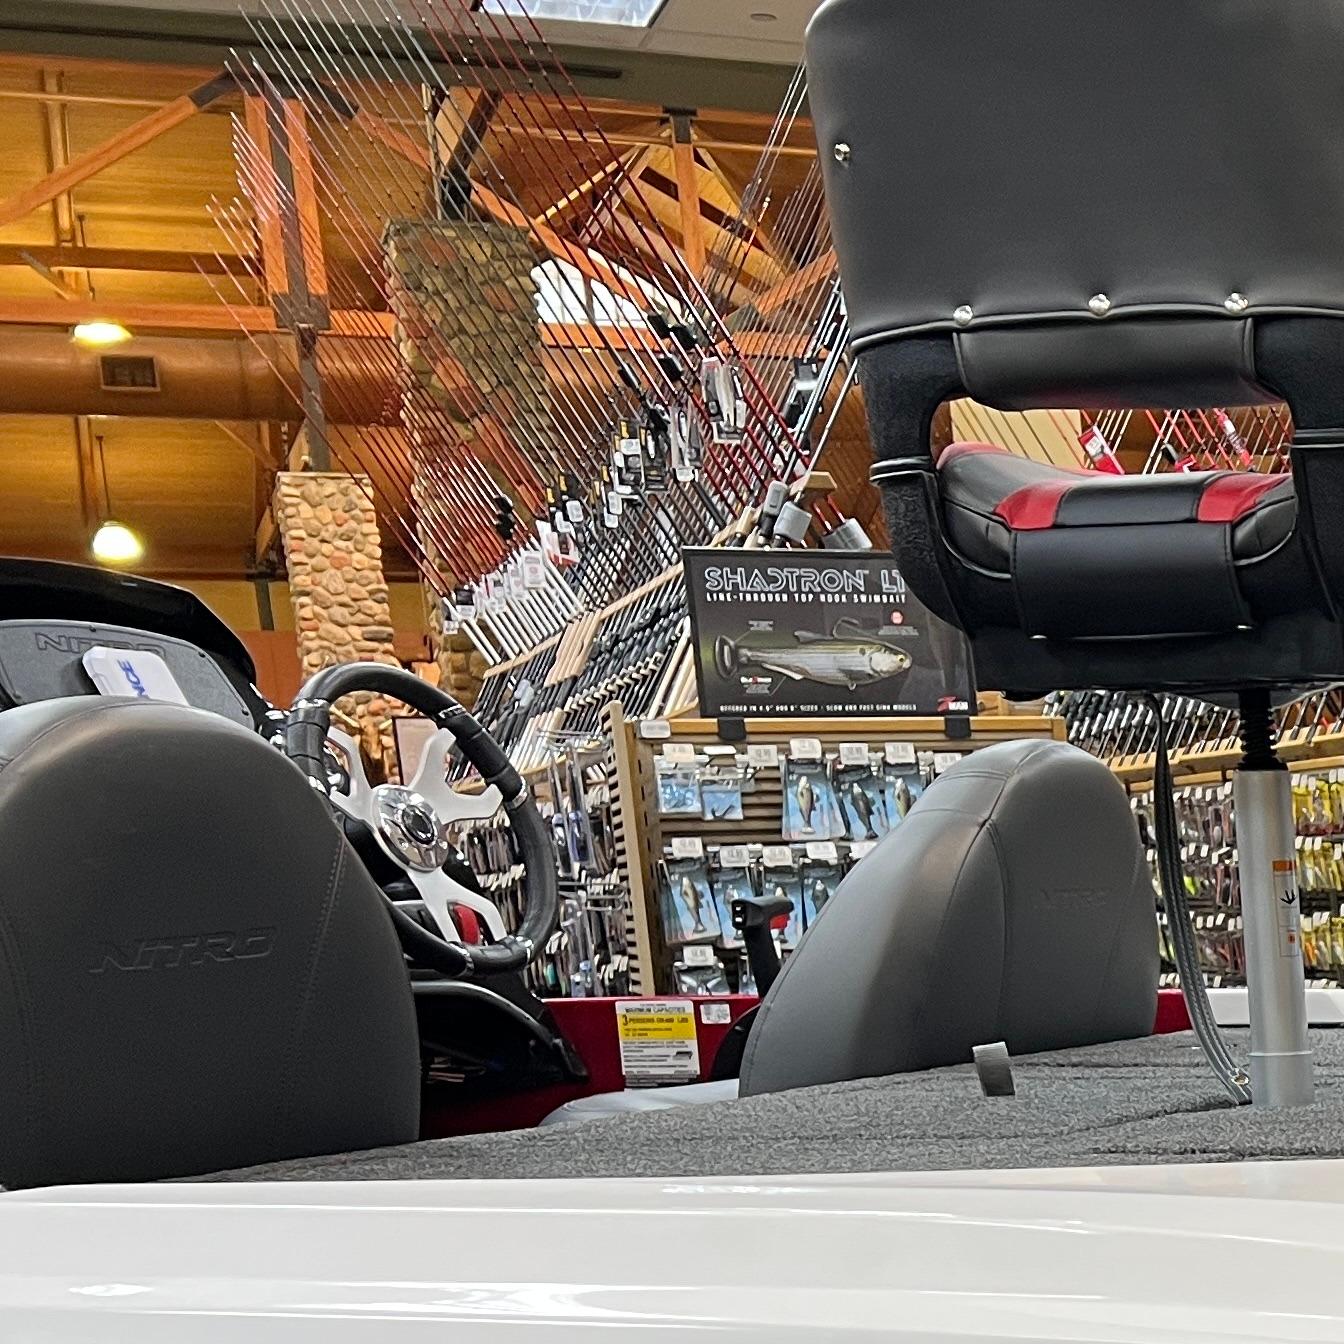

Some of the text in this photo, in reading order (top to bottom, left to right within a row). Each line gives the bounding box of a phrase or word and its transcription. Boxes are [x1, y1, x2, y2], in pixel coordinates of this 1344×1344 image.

[705, 567, 865, 592] SHADTRON
[794, 593, 814, 602] TOP
[88, 926, 277, 973] NITRO
[622, 1014, 628, 1026] 3
